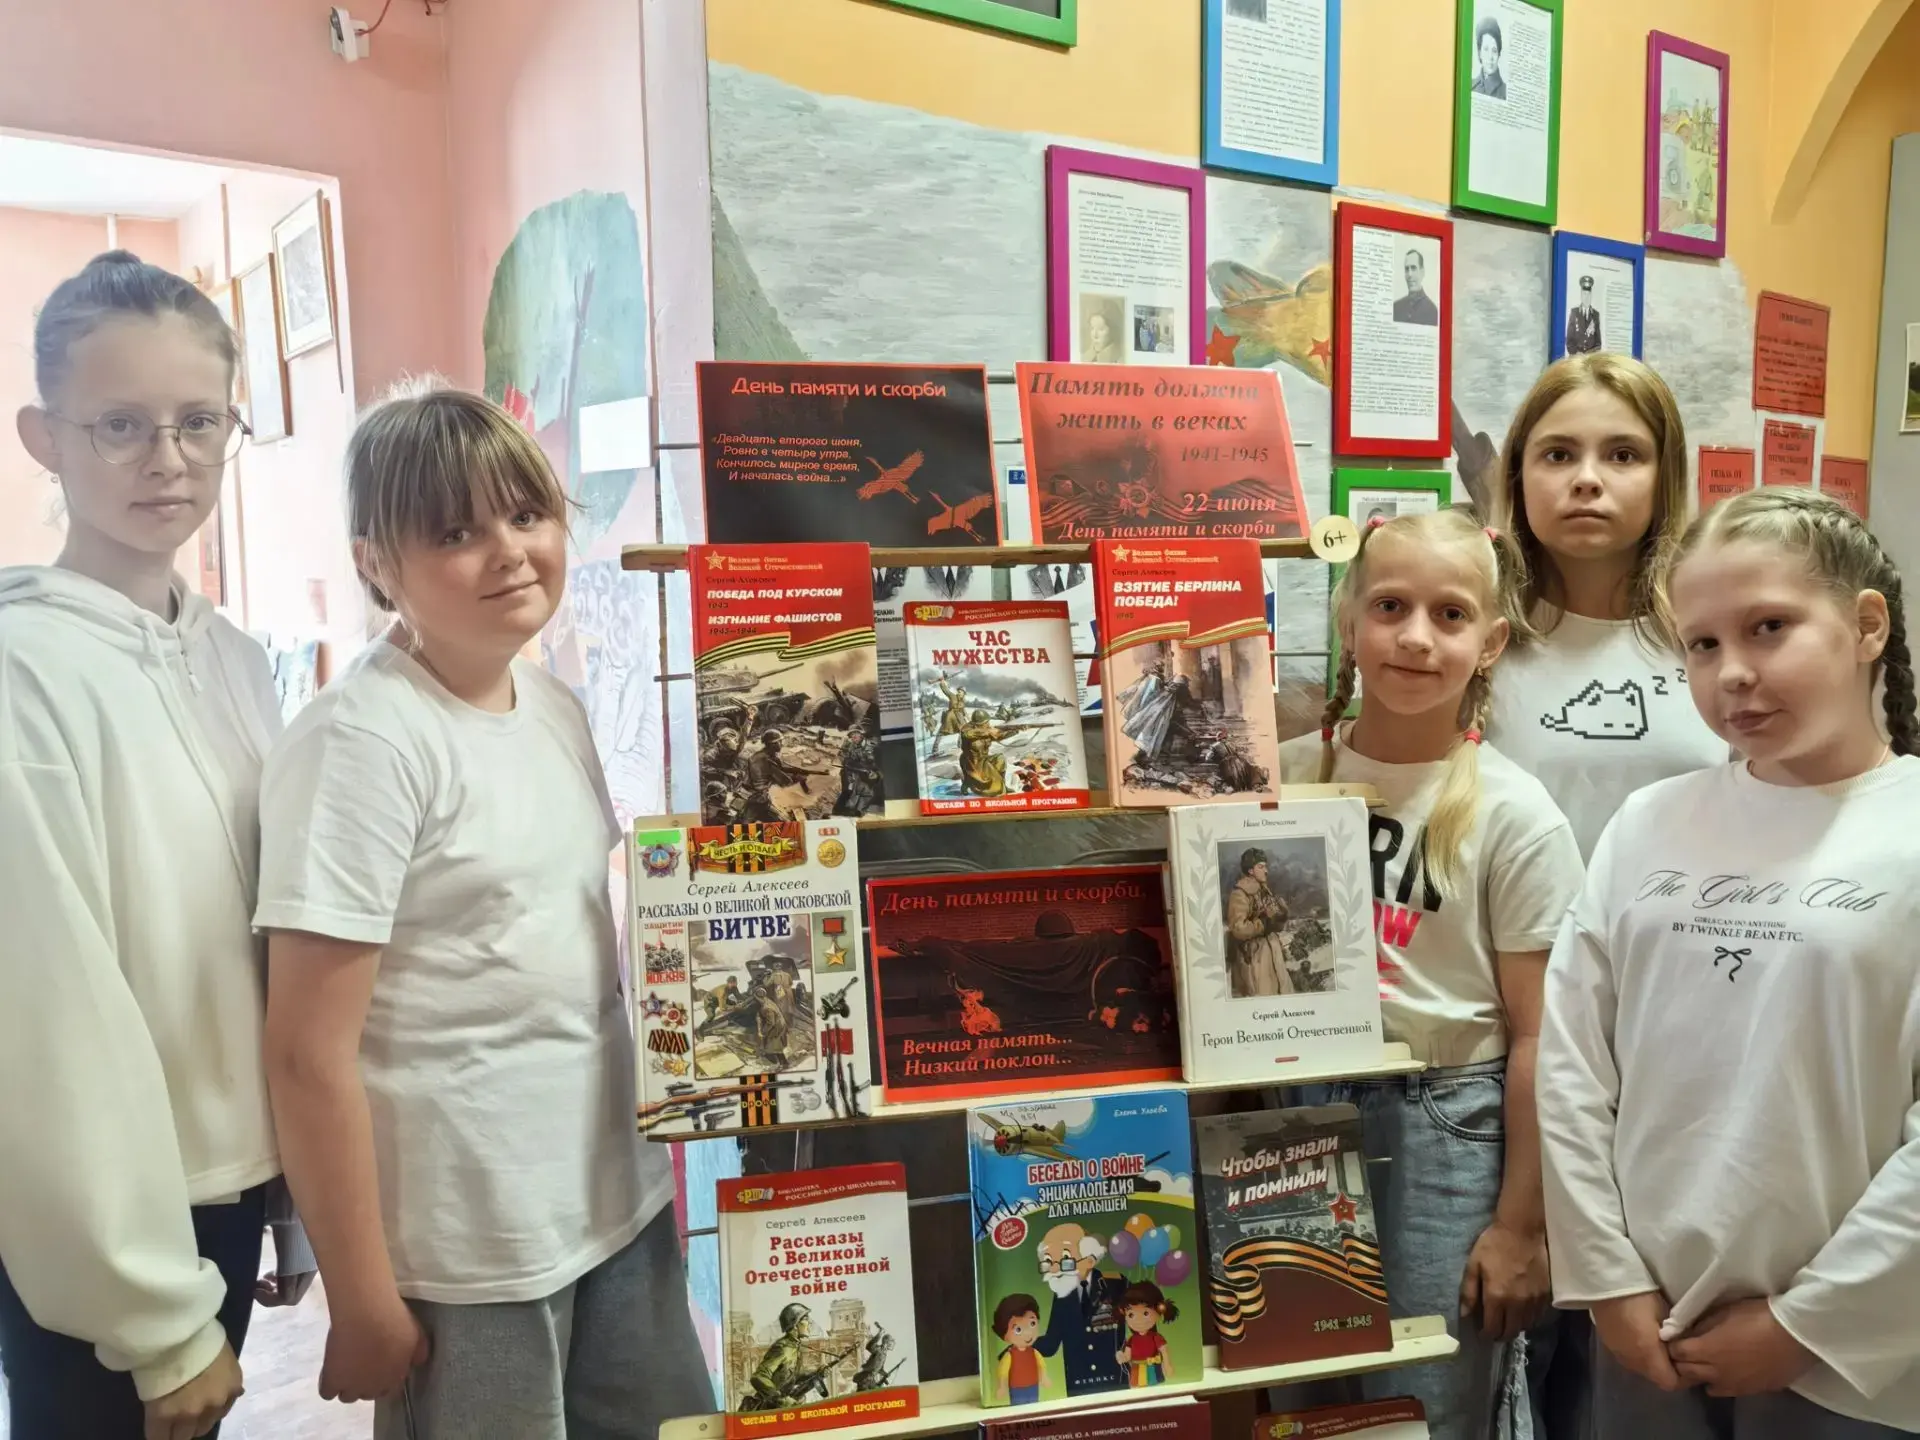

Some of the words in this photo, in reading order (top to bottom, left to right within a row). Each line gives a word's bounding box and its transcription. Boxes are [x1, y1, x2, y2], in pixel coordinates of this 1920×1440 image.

[731, 377, 784, 396] День
[790, 380, 859, 397] памяти
[864, 383, 876, 397] и
[881, 381, 946, 399] скорби
[1030, 372, 1145, 397] Память
[1154, 377, 1259, 399] должна
[1056, 410, 1141, 431] жить
[1151, 414, 1164, 431] в
[1173, 413, 1247, 431] веках
[779, 436, 828, 447] второго
[831, 437, 863, 448] июня,
[723, 446, 758, 456] Ровно
[761, 448, 768, 456] в
[771, 448, 816, 459] четыре
[819, 450, 851, 460] утра,
[1180, 446, 1268, 462] 1941-1945
[716, 457, 777, 469] Кончилось
[779, 461, 820, 471] мирное
[823, 462, 860, 473] время,
[729, 471, 738, 481] И
[741, 472, 794, 482] началась
[1183, 493, 1208, 512] 22
[1216, 495, 1277, 512] июня
[1058, 521, 1105, 540] День
[1111, 523, 1188, 539] памяти
[1194, 524, 1206, 536] и
[1212, 520, 1275, 540] скорби
[1323, 530, 1347, 549] 6+
[707, 590, 755, 600] ПОБЕДА
[758, 589, 783, 599] ПОД
[785, 588, 843, 598] КУРСКОМ
[1113, 581, 1170, 593] ВЗЯТИЕ
[1174, 580, 1242, 592] БЕРЛИНА
[1114, 596, 1178, 609] ПОБЕДА!
[708, 614, 771, 625] ИЗГНАНИЕ
[773, 612, 842, 623] ФАШИСТОВ
[968, 630, 1011, 647] ЧАС
[932, 647, 1051, 666] МУЖЕСТВА
[970, 800, 981, 808] ПО
[714, 846, 737, 858] ЧЕСТЬ
[746, 845, 777, 856] ОТВАГА
[687, 881, 737, 899] Сергей
[742, 879, 809, 894] Алексеев
[1635, 870, 1690, 902] The
[1692, 875, 1790, 909] Girl's
[1799, 878, 1892, 912] Club
[638, 903, 699, 919] РАССКАЗЫ
[703, 903, 711, 915] О
[715, 895, 771, 914] ВЕЛИКОЙ
[774, 889, 852, 909] МОСКОВСКОЙ
[881, 892, 938, 916] День
[945, 885, 1038, 907] памяти
[1044, 886, 1059, 902] и
[709, 914, 791, 941] БИТВЕ
[1672, 921, 1685, 932] BY
[1688, 924, 1742, 938] TWINKLE
[1252, 1010, 1279, 1021] Сергей
[1281, 1009, 1316, 1019] Алексеев
[1201, 1032, 1233, 1048] Герои
[1237, 1027, 1284, 1044] Великой
[1287, 1020, 1372, 1039] Отечественной
[902, 1038, 972, 1056] Вечная
[977, 1032, 1073, 1050] память...
[904, 1056, 979, 1077] Низкий
[984, 1054, 1072, 1071] поклон...
[1221, 1146, 1280, 1178] Чтобы
[1284, 1135, 1339, 1163] знали
[1029, 1159, 1084, 1184] БЕСЕДЫ
[1087, 1162, 1098, 1177] О
[1102, 1153, 1145, 1177] ВОЙНЕ
[785, 1186, 846, 1201] РОССИЙСКОГО
[1038, 1178, 1135, 1203] ЭНЦИКЛОПЕДИЯ
[1227, 1189, 1240, 1208] и
[1244, 1167, 1328, 1203] помнили
[1048, 1203, 1069, 1218] ДЛЯ
[1073, 1196, 1127, 1216] МАЛЫШЕЙ
[766, 1218, 806, 1229] Сергей
[813, 1213, 866, 1225] Алексеев
[770, 1232, 864, 1250] Рассказы
[769, 1255, 779, 1266] о
[786, 1244, 866, 1265] Великой
[745, 1257, 890, 1285] Отечественной
[790, 1278, 848, 1296] войне
[1075, 1375, 1116, 1385] ФЕНИКС
[741, 1415, 777, 1426] ЧИТАЕМ
[783, 1412, 795, 1421] ПО
[801, 1405, 848, 1420] ШКОЛЬНОЙ
[853, 1399, 906, 1413] ПРОГРАММЕ
